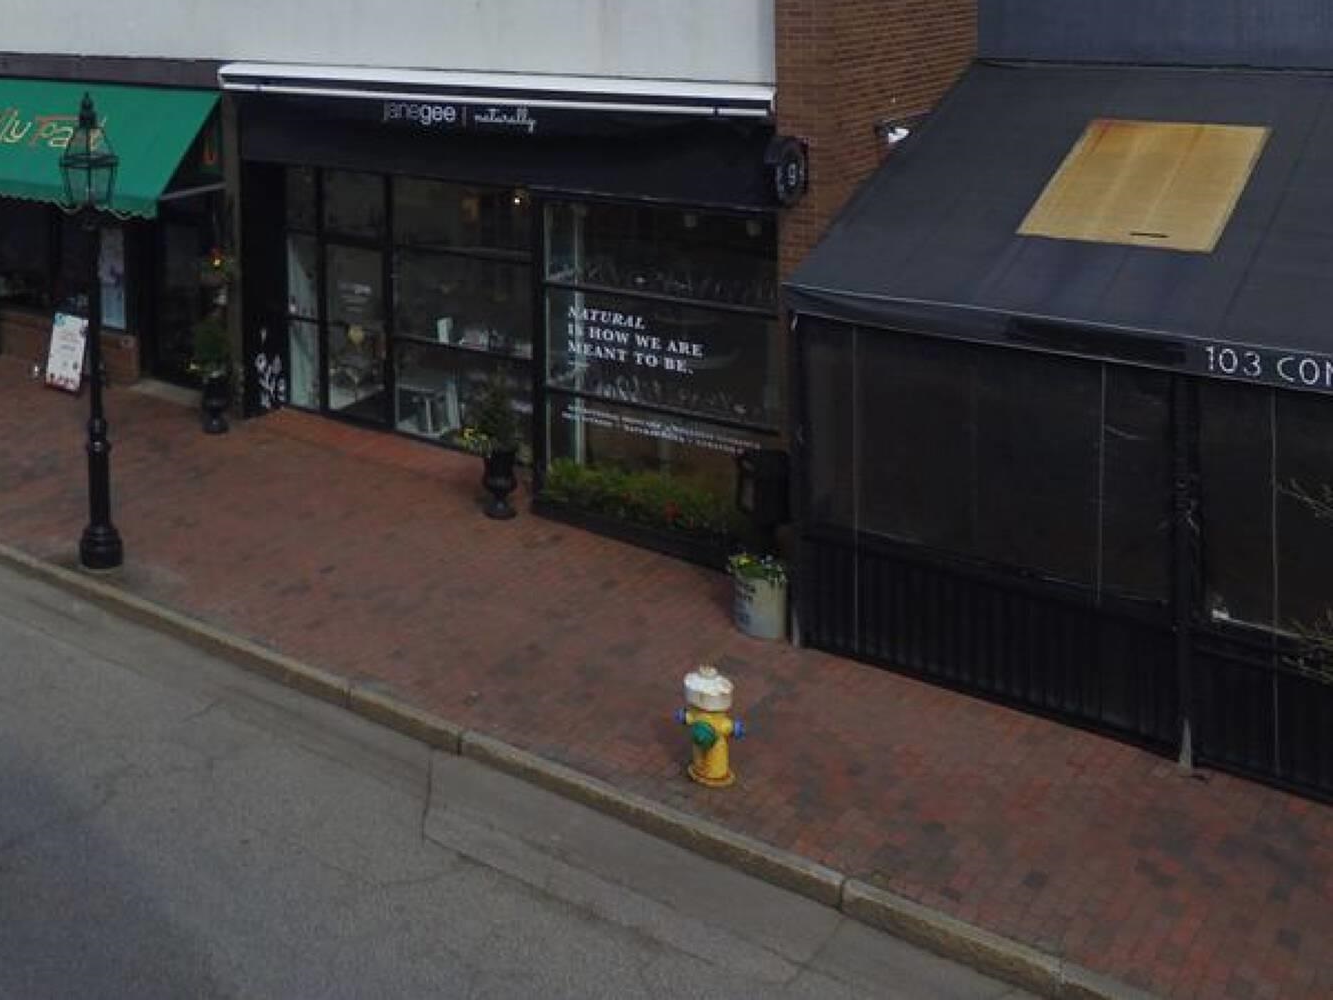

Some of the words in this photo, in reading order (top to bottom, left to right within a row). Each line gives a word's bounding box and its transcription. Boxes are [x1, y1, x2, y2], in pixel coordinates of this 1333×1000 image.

[382, 101, 456, 126] janegee
[568, 306, 646, 330] NATURAL
[568, 340, 627, 363] MEANT
[633, 350, 659, 368] TO
[588, 326, 629, 344] HOW
[635, 333, 662, 350] WE
[667, 340, 704, 358] ARE
[1205, 345, 1263, 377] 103
